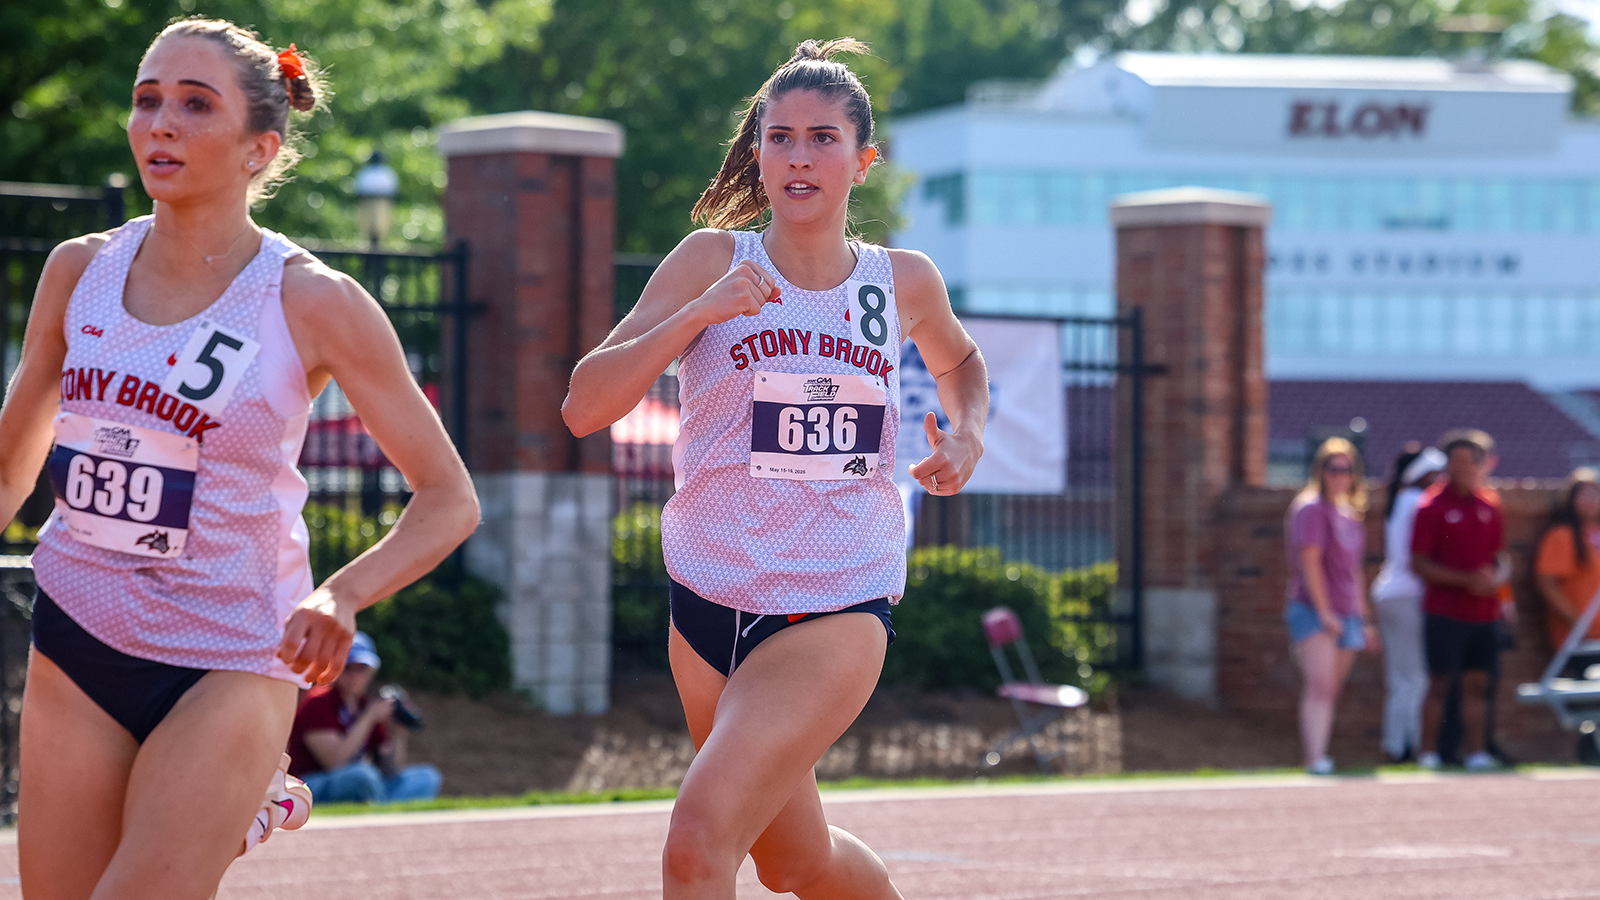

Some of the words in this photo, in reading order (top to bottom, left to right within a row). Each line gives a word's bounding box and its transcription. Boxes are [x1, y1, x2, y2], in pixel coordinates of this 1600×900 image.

[1287, 101, 1431, 138] ELON
[858, 284, 888, 347] 8
[177, 330, 244, 401] 5
[729, 328, 811, 371] STONY
[819, 333, 894, 388] BROOK
[803, 383, 829, 393] TRACK
[117, 375, 222, 444] BROOK
[777, 405, 859, 453] 636
[65, 453, 165, 523] 639
